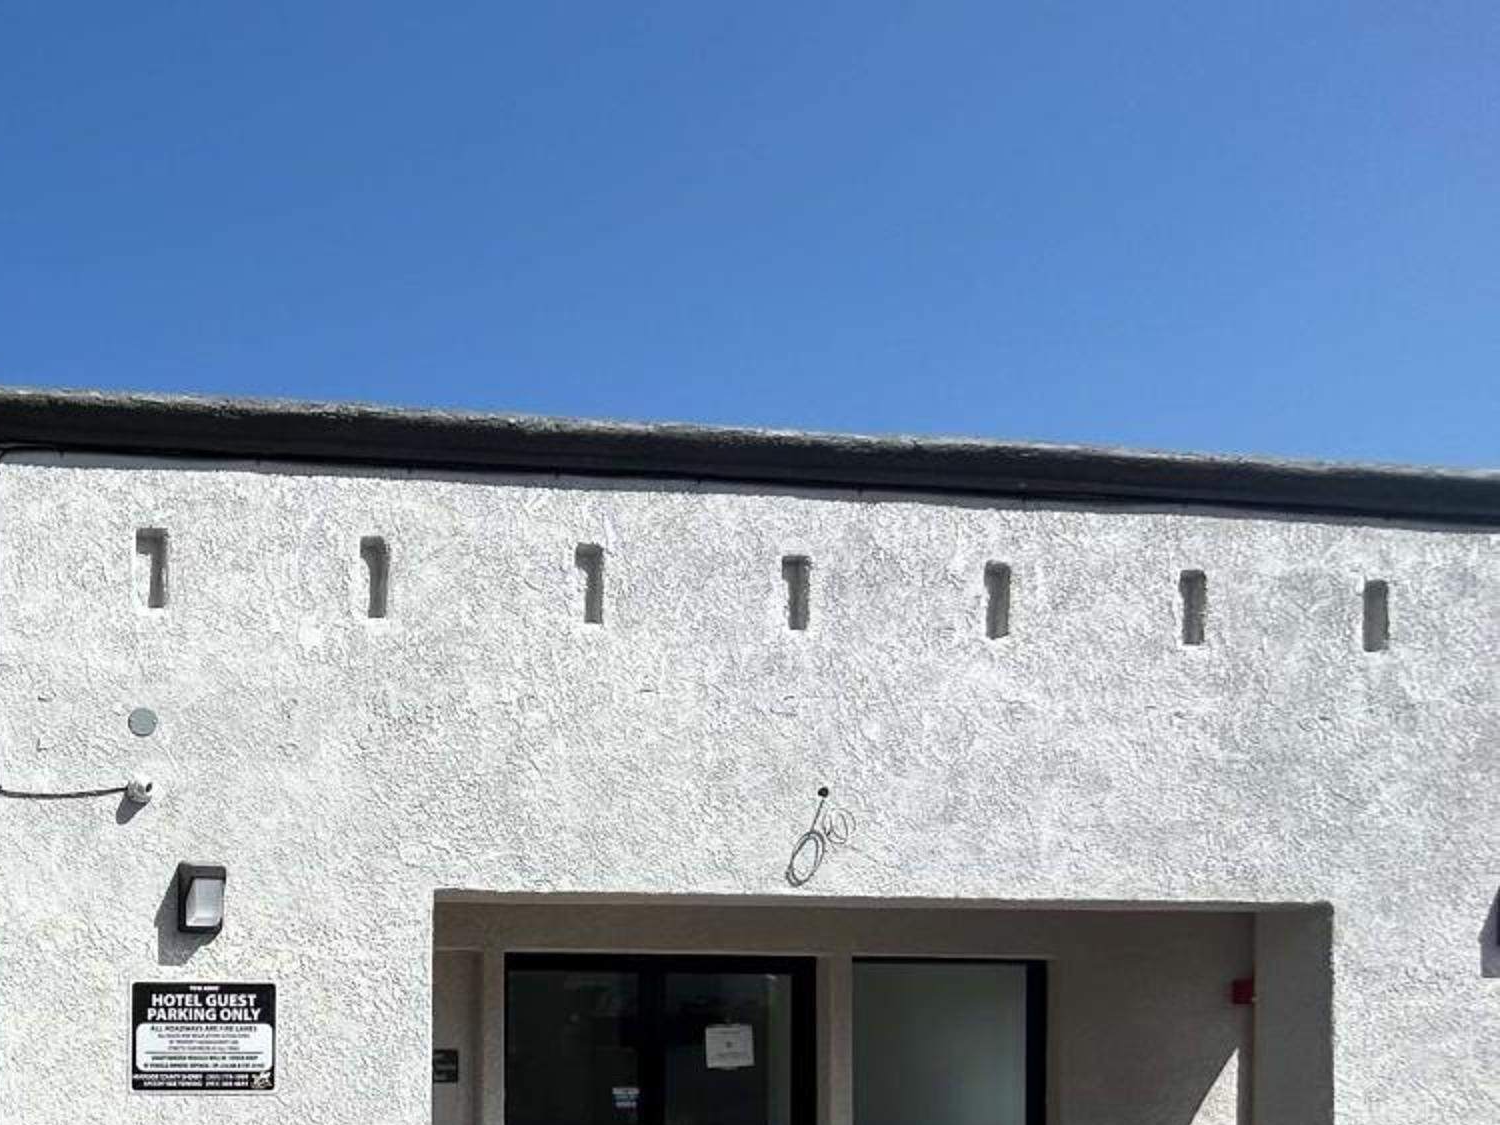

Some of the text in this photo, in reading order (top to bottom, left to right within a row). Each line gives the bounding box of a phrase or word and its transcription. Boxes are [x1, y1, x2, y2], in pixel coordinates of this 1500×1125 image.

[151, 993, 257, 1007] HOTEL GUEST
[147, 1007, 261, 1021] PARKING ONLY
